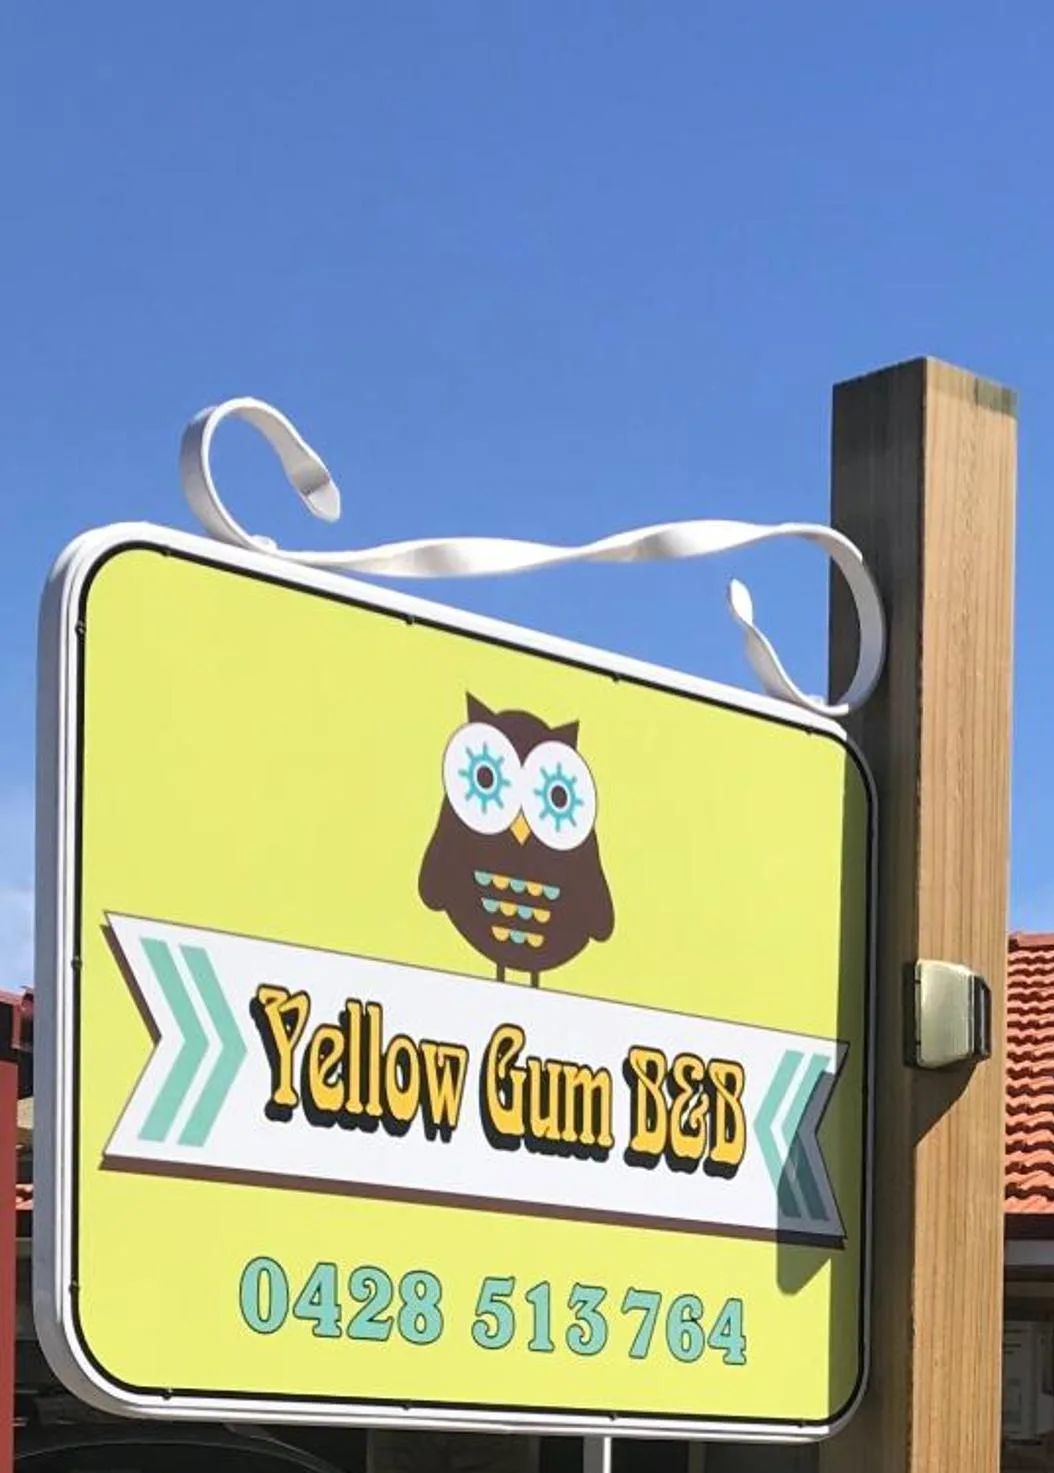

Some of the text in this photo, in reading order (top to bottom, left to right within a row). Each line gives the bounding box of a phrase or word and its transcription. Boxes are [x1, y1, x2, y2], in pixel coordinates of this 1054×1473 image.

[249, 983, 748, 1179] Yellow Gum B&B
[239, 1256, 444, 1345] 0428
